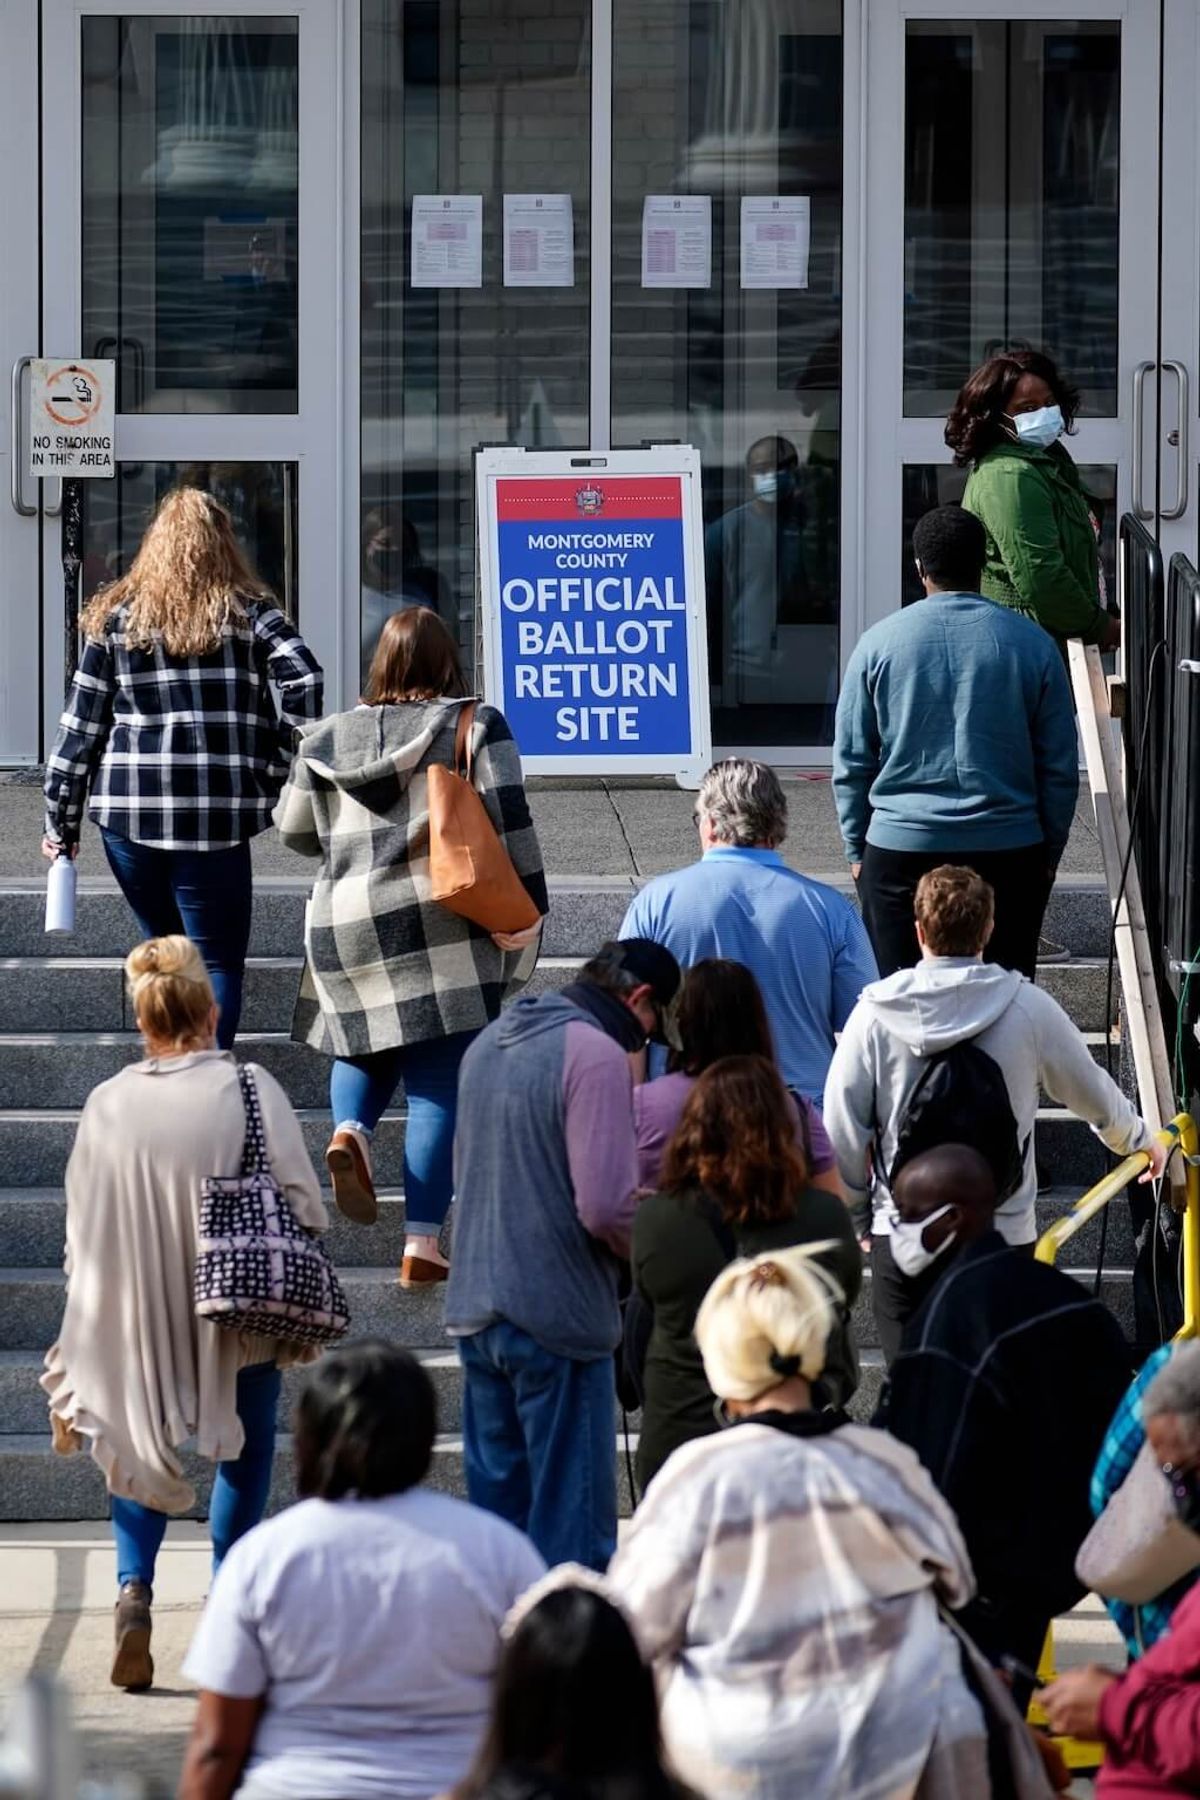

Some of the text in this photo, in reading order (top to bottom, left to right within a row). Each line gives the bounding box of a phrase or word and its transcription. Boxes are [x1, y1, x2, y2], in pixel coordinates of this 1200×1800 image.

[33, 436, 111, 449] NO SMOKING
[32, 453, 44, 465] IN
[79, 453, 111, 465] AREA
[528, 533, 655, 549] MONTGOMERY
[555, 553, 628, 569] COUNTY
[502, 577, 686, 613] OFFICIAL
[518, 620, 673, 655] BALLOT
[515, 663, 677, 698] RETURN
[556, 706, 640, 741] SITE
